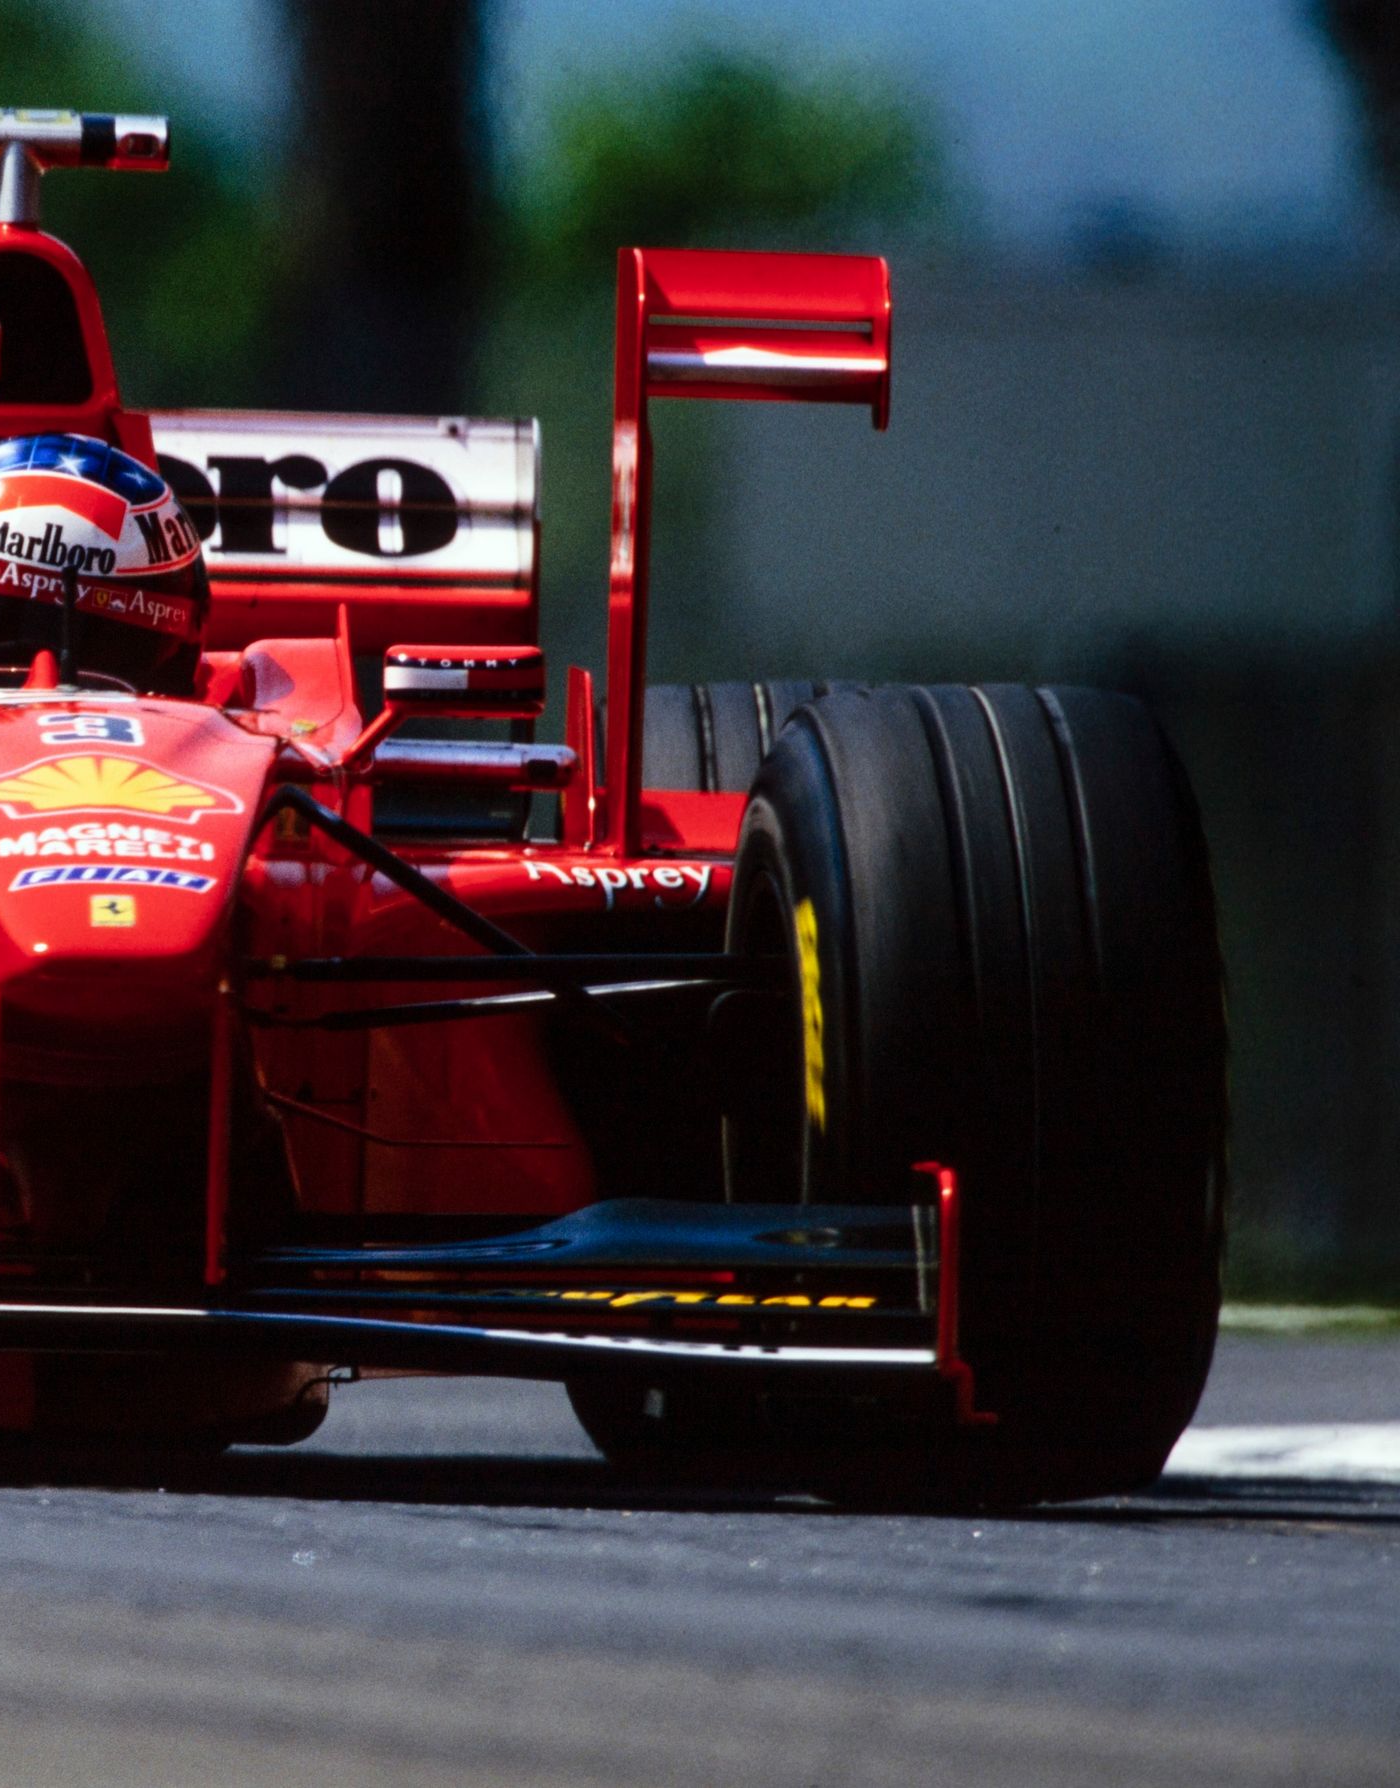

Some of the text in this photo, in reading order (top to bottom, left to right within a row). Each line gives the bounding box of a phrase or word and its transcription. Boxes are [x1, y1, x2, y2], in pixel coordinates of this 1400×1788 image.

[418, 657, 518, 668] TOMMY
[37, 712, 145, 747] 3
[21, 866, 205, 888] FIAT
[520, 859, 711, 910] Asprey
